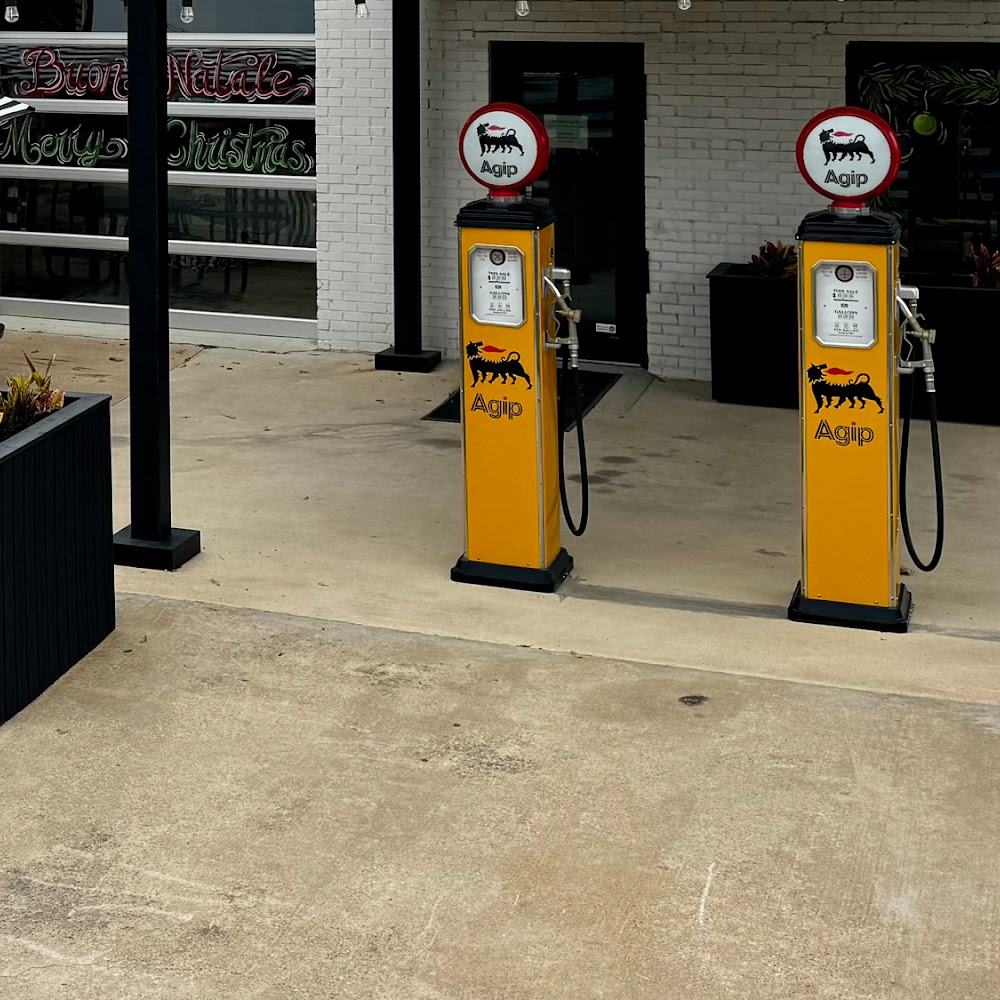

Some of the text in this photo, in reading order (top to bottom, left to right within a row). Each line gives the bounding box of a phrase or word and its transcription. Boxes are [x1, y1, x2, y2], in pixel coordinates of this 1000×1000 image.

[19, 46, 314, 100] Buon Natale
[480, 159, 518, 178] Agip
[823, 169, 869, 188] Agip
[470, 392, 523, 420] Agip
[814, 419, 875, 447] Agip
